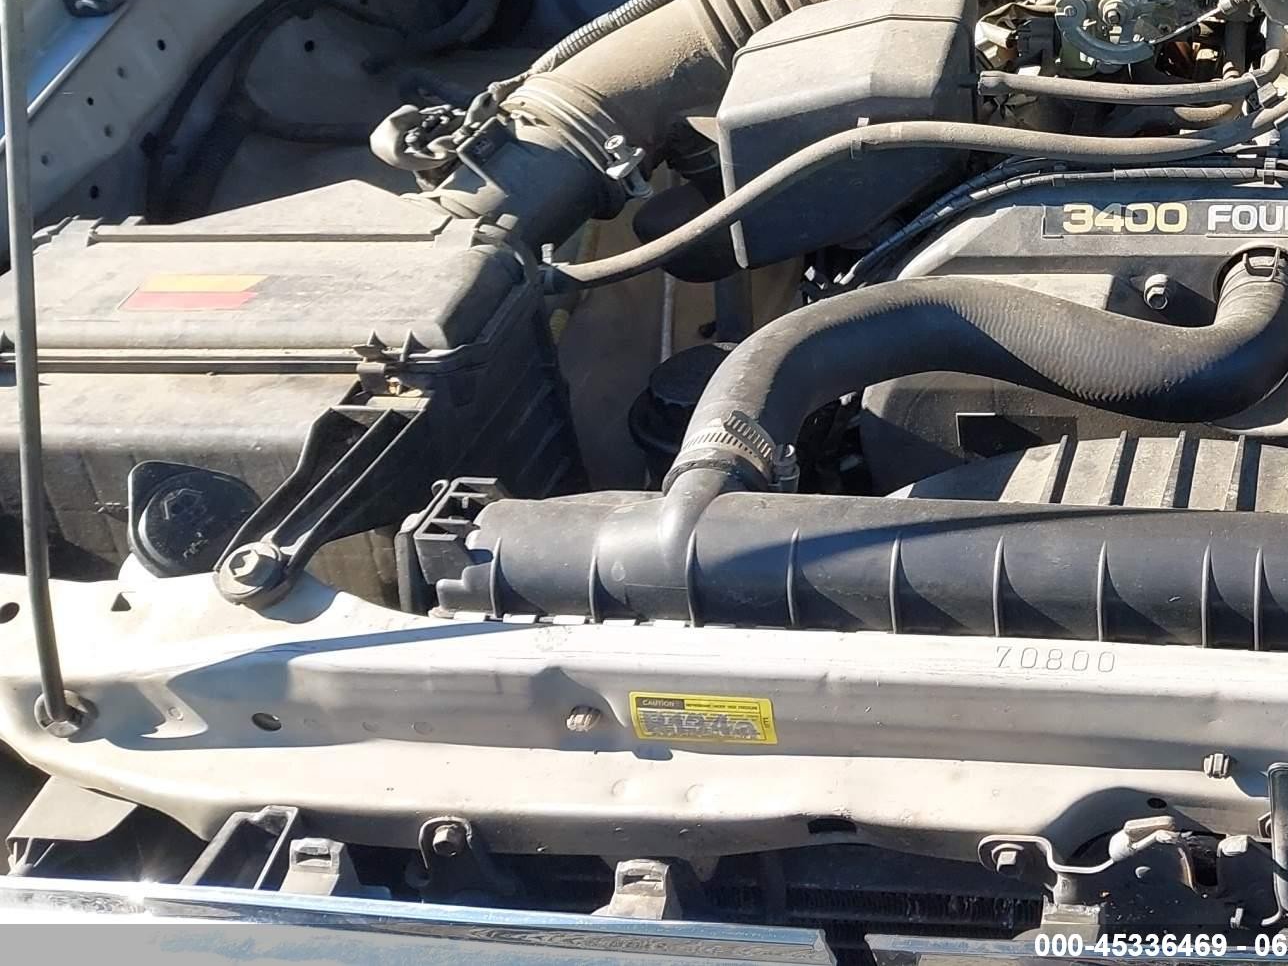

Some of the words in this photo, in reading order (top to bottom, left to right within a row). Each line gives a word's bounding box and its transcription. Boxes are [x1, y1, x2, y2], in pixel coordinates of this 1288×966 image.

[1062, 202, 1188, 234] 3400
[996, 645, 1116, 673] 70800
[642, 699, 675, 708] CAUTION
